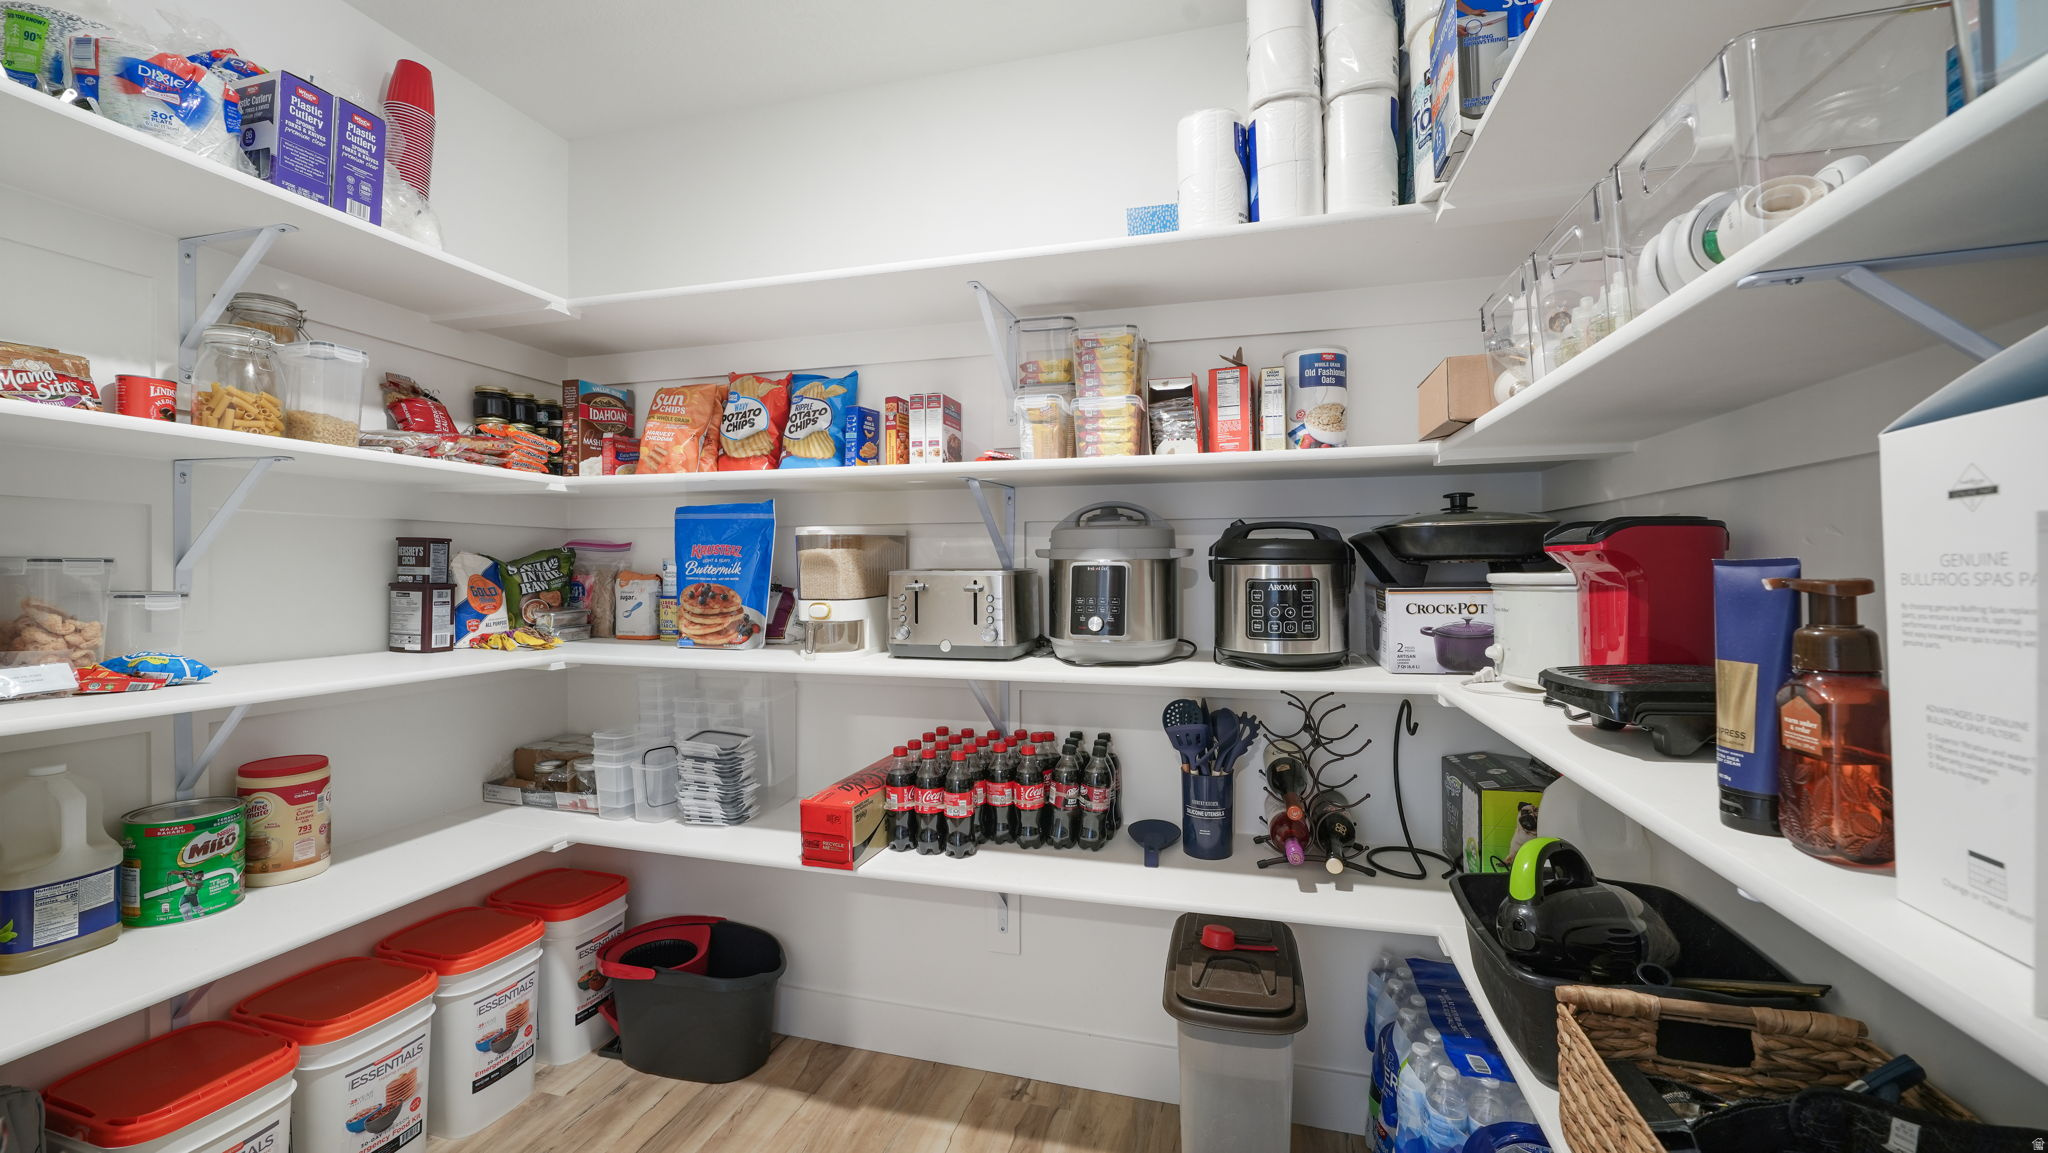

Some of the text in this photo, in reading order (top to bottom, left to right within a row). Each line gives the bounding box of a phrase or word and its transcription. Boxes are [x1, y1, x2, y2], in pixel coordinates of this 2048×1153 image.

[251, 92, 273, 106] Cutlery
[290, 95, 323, 118] Plastic
[289, 104, 324, 130] Cutlery
[347, 121, 377, 143] Plastic
[311, 138, 327, 148] clear
[345, 130, 377, 154] Cutlery
[0, 370, 58, 391] Mama
[1304, 367, 1346, 378] Old Fashioned
[1321, 375, 1336, 384] Oats
[34, 381, 79, 400] Sita's
[652, 393, 685, 411] Sun
[659, 405, 687, 415] CHIPS
[794, 402, 815, 412] RIPPLE
[589, 407, 628, 423] IDAHOAN
[721, 407, 762, 425] POTATO
[789, 406, 828, 424] OTATO
[646, 429, 676, 437] HARVEST
[725, 417, 756, 434] CHIPS
[787, 416, 820, 435] CHIPS
[690, 544, 743, 559] KRUSTEAZ
[1939, 550, 2010, 568] GENUINE
[685, 560, 742, 576] Buttermilk
[521, 570, 537, 583] IN
[1900, 571, 1970, 587] BULLFROG
[1973, 571, 2015, 587] SPAS
[469, 585, 499, 597] GOLD
[520, 581, 549, 595] RAW
[1267, 583, 1298, 591] AROMA
[619, 594, 635, 602] sugar
[1396, 642, 1404, 653] 2
[1926, 704, 1973, 721] ADVANTAGES
[1988, 715, 2031, 733] GENUINE
[1926, 714, 1964, 731] BULLFROG
[246, 803, 268, 814] offee
[246, 809, 269, 820] mate
[298, 824, 313, 833] 793
[187, 832, 238, 860] MILO
[822, 840, 845, 848] RECYCLE
[477, 977, 535, 1017] ESSENTIALS
[350, 1042, 424, 1091] ESSENTIALS
[474, 1056, 510, 1079] Emergency
[510, 1045, 525, 1057] Food
[525, 1038, 535, 1048] Kit
[359, 1112, 422, 1153] rgency Food Kit
